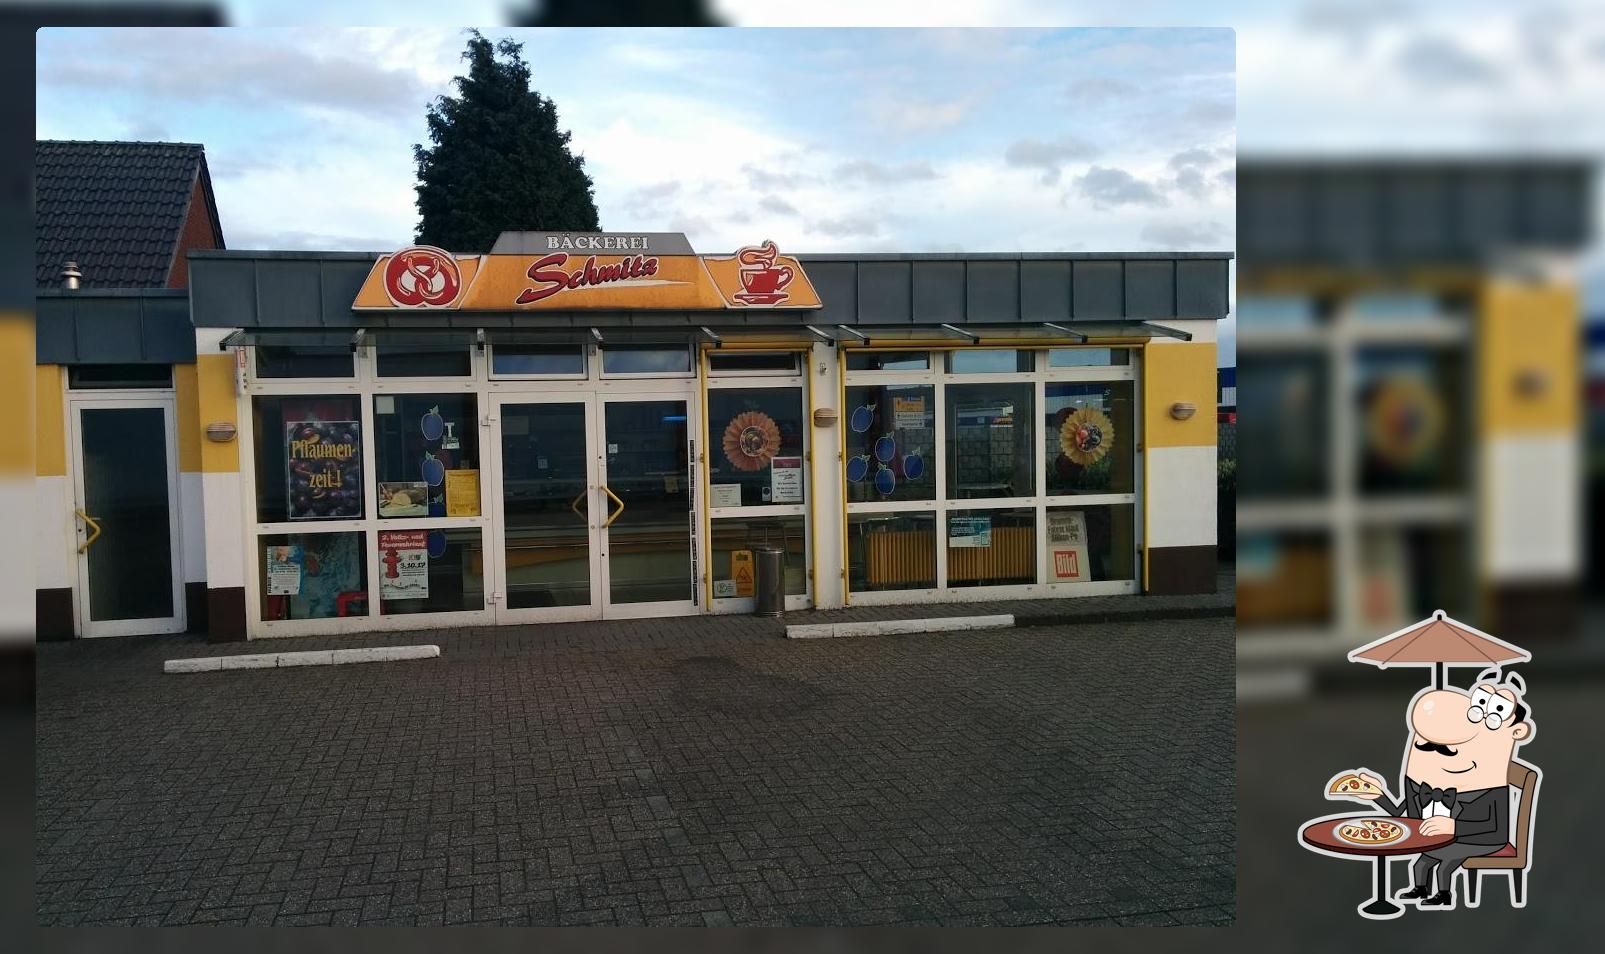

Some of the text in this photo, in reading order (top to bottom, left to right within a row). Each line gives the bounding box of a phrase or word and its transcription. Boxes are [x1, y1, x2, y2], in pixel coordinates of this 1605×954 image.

[546, 233, 649, 250] BÄCKEREI
[515, 252, 660, 305] Schmitz
[291, 439, 357, 461] Pflaumen-
[1056, 553, 1078, 575] Bild
